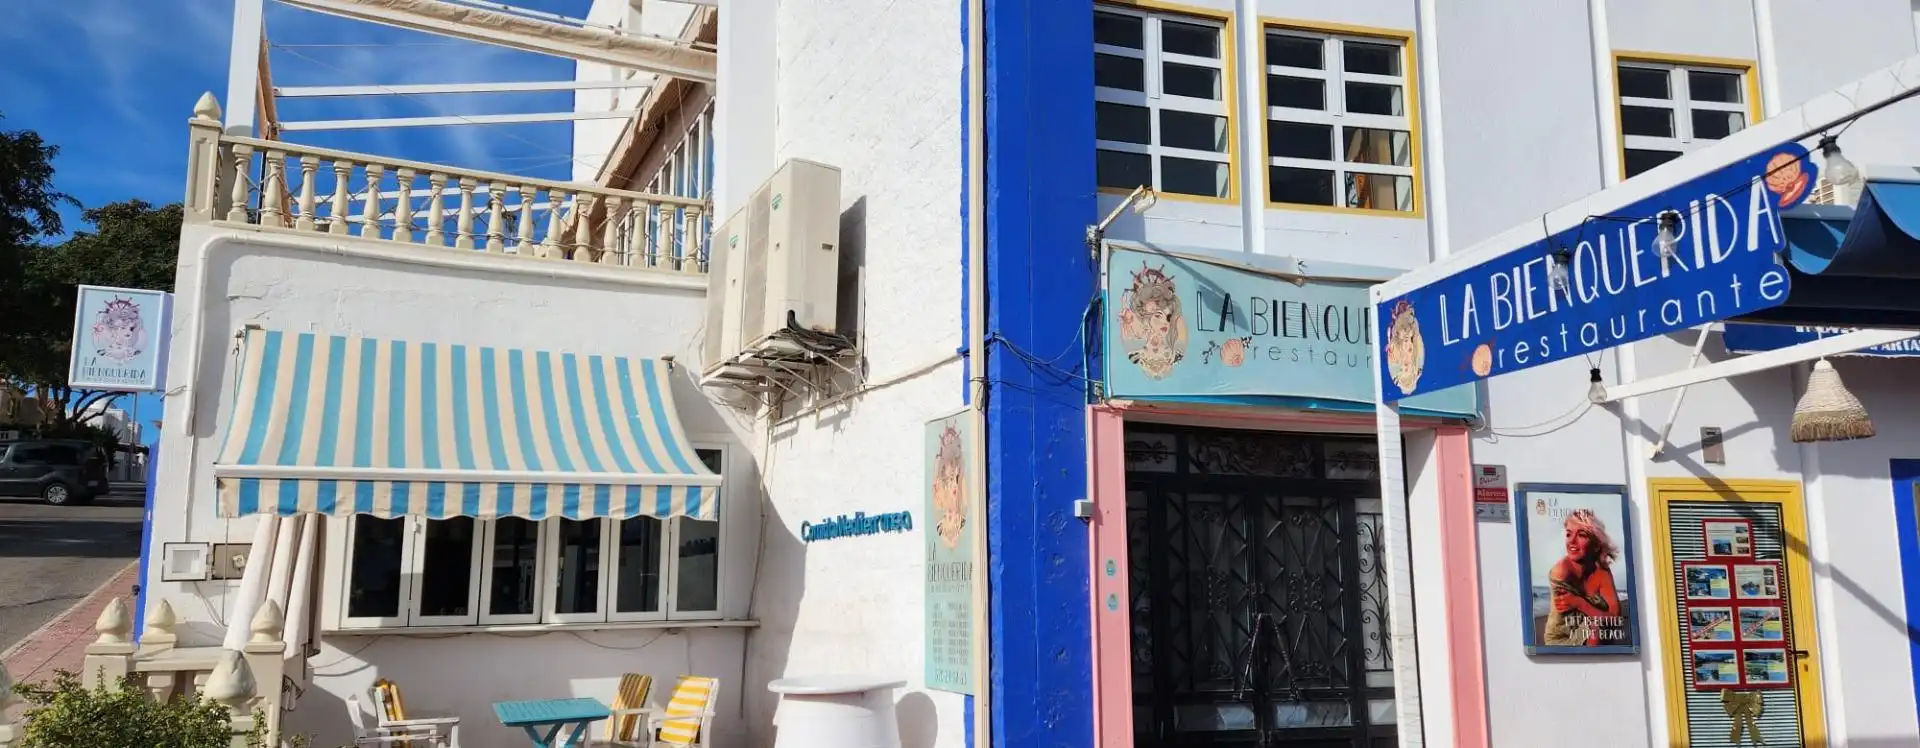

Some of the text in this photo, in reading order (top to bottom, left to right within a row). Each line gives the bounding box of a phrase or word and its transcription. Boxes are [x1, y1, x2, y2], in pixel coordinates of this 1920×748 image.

[1439, 175, 1780, 346] LA BIENQUERIDA
[1196, 291, 1236, 333] LA
[1498, 270, 1785, 369] restaurante
